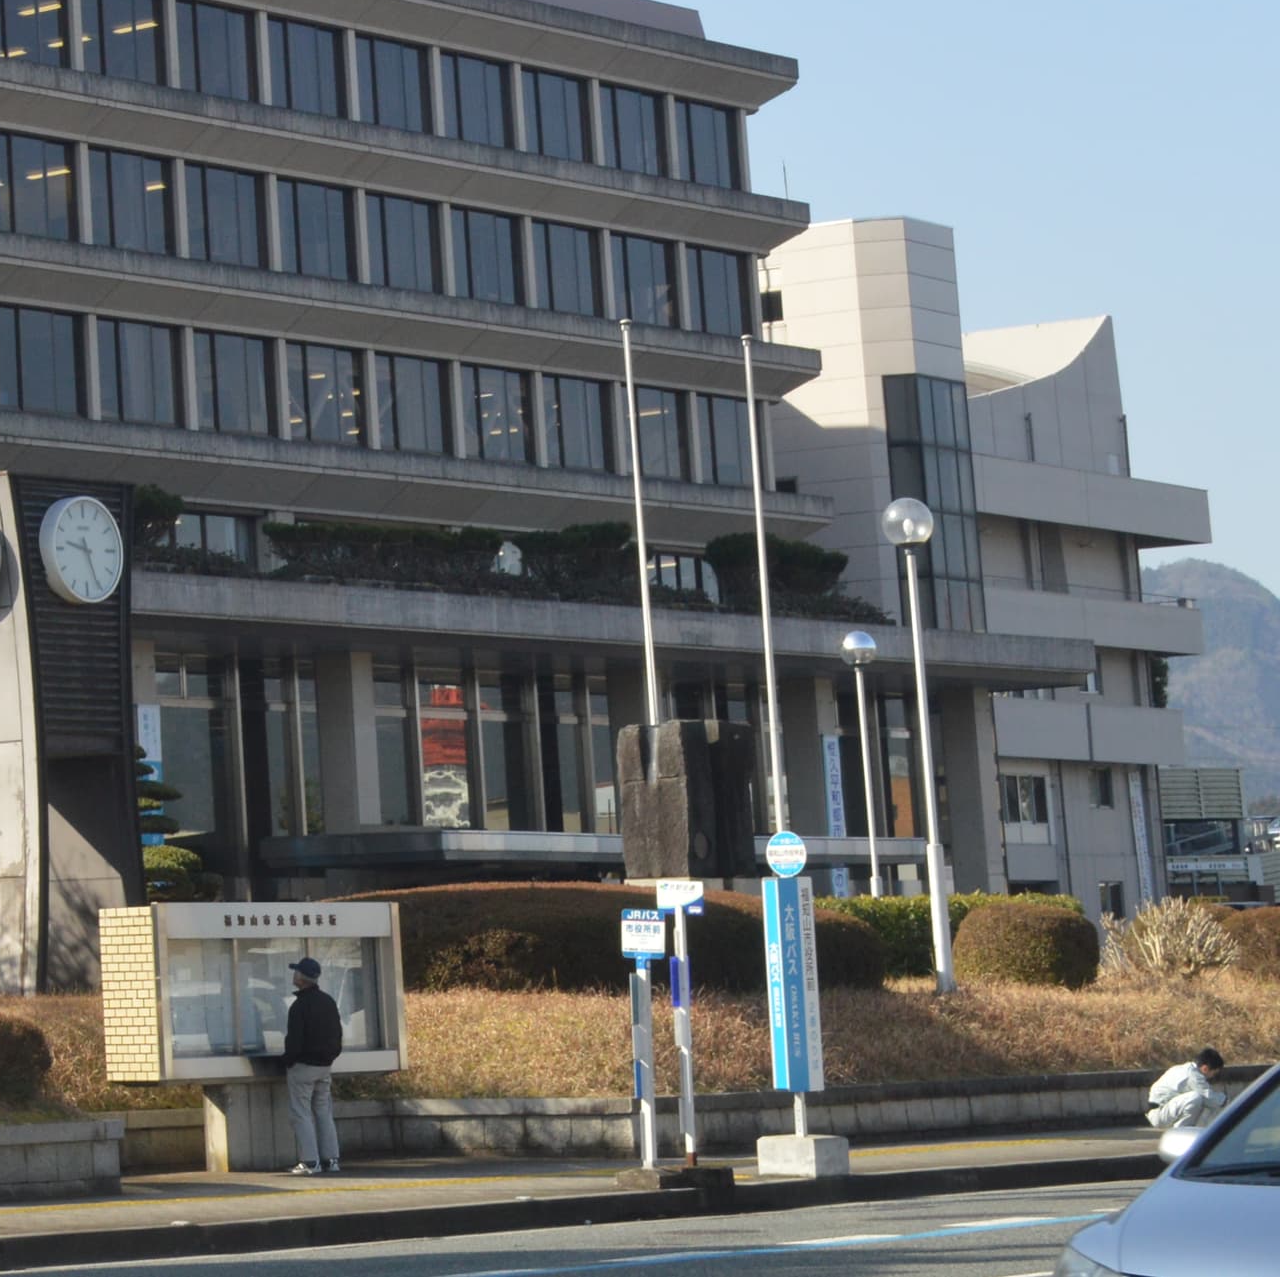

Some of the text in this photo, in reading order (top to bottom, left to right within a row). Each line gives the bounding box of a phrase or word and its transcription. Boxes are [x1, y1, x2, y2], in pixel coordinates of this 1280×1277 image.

[626, 910, 659, 920] JRバス
[626, 924, 661, 934] 市役所前
[784, 904, 798, 975] 大阪バス
